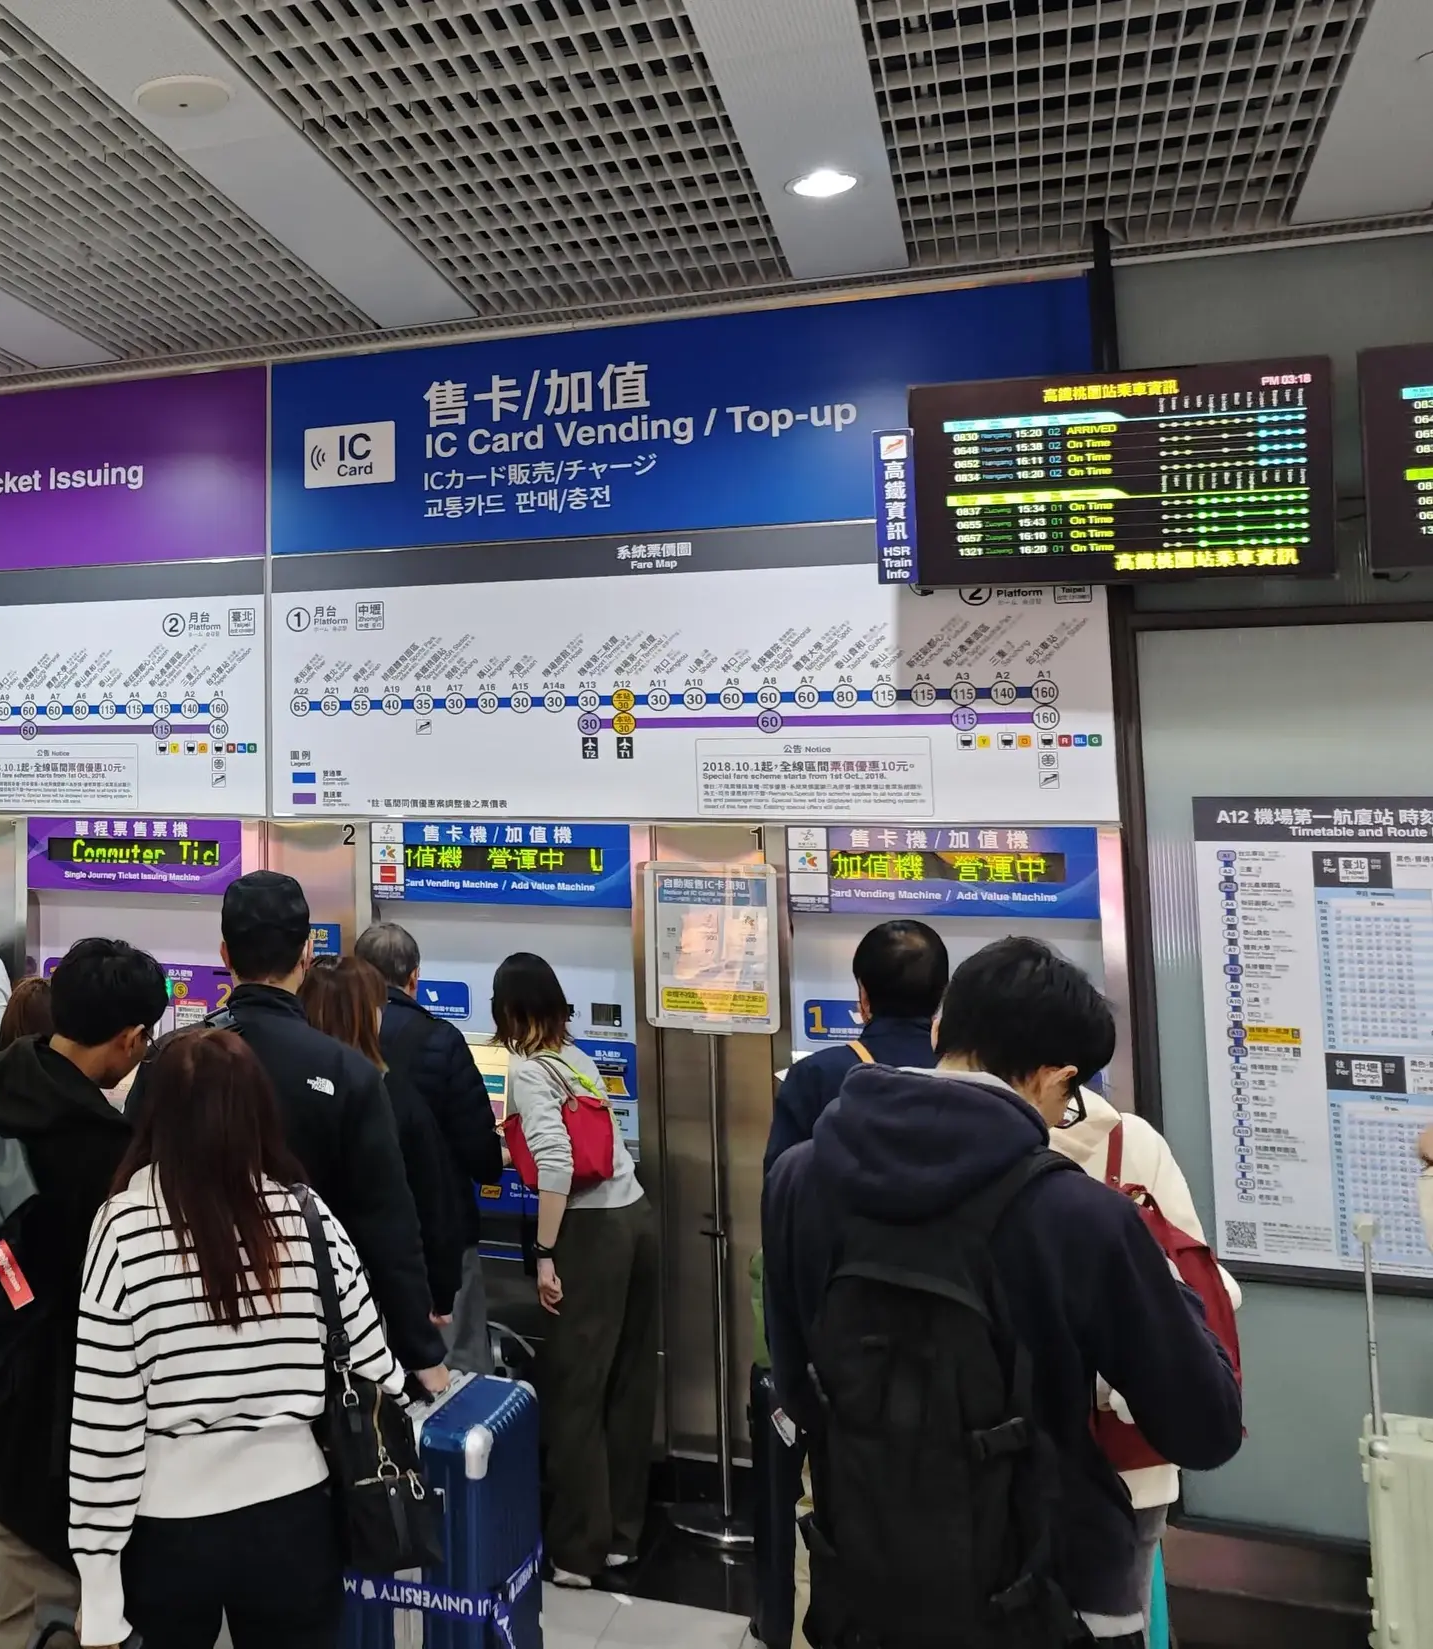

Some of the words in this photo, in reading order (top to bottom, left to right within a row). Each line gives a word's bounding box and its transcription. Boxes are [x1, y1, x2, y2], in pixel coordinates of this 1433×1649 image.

[1261, 376, 1280, 385] PM
[423, 360, 650, 427] 售卡/加值
[425, 431, 457, 458] IC
[468, 424, 543, 455] Card
[555, 409, 694, 446] Vending
[703, 408, 718, 436] /
[726, 402, 857, 438] Top-up
[1015, 429, 1042, 438] 15:20
[1066, 424, 1117, 435] ARRIVED
[339, 432, 371, 461] IC
[1067, 440, 1084, 449] On
[1086, 439, 1111, 448] Time
[1067, 454, 1084, 463] On
[1086, 453, 1112, 461] Time
[337, 462, 373, 477] Card
[423, 453, 658, 491] ICカード販売/チャージ
[1068, 468, 1085, 476] On
[1087, 467, 1112, 475] Time
[49, 462, 144, 490] Issuing
[423, 493, 505, 519] 교통카드
[515, 485, 611, 514] 판매/충전
[883, 461, 908, 541] 高鐵資訊
[1070, 517, 1087, 525] On
[1088, 516, 1114, 524] Time
[616, 542, 692, 560] 系統票價圖
[883, 546, 911, 557] HSR
[631, 560, 653, 569] Fare
[656, 559, 677, 569] Map
[882, 557, 912, 569] Train
[886, 569, 910, 579] Info
[997, 588, 1043, 598] Platform
[313, 606, 337, 617] 月台
[358, 604, 381, 616] 中壢
[188, 612, 210, 624] 月台
[231, 612, 253, 622] 臺北
[313, 617, 348, 625] Platform
[168, 618, 178, 632] 2
[188, 623, 221, 631] Platform
[1037, 670, 1052, 679] A1
[543, 682, 565, 690] A14a
[579, 681, 596, 689] A13
[613, 680, 631, 688] A12
[763, 677, 777, 685] A8
[294, 702, 307, 712] 65
[1035, 712, 1056, 723] 160
[582, 719, 597, 729] 30
[783, 745, 802, 754] 公告
[805, 745, 831, 753] Notice
[1217, 810, 1249, 824] A12
[1254, 807, 1394, 826] 機場第一航廈站
[75, 821, 189, 838] 單程票售票機
[343, 824, 355, 845] 2
[1289, 826, 1354, 837] Timetable
[1358, 827, 1383, 837] and
[1387, 827, 1428, 837] Route
[751, 826, 764, 850] 1
[72, 839, 165, 864] Commuter
[487, 847, 565, 871] 營運中
[1341, 859, 1366, 870] 臺北
[832, 854, 925, 881] 加值機
[954, 855, 1047, 883] 營運中
[1323, 866, 1337, 874] For
[64, 871, 86, 881] Single
[88, 871, 117, 882] Journey
[118, 872, 139, 881] Ticket
[141, 872, 168, 882] Issuing
[169, 873, 200, 881] Machine
[426, 879, 460, 889] Vending
[462, 880, 498, 889] Machine
[511, 881, 529, 890] Add
[531, 882, 555, 891] Value
[557, 882, 595, 892] Machine
[854, 889, 895, 901] Vending
[898, 890, 942, 899] Machine
[957, 891, 977, 901] Add
[980, 892, 1009, 901] Value
[1012, 892, 1057, 902] Machine
[217, 984, 233, 1008] 2
[808, 1006, 828, 1033] 1
[380, 1583, 473, 1616] UNIVERSITY
